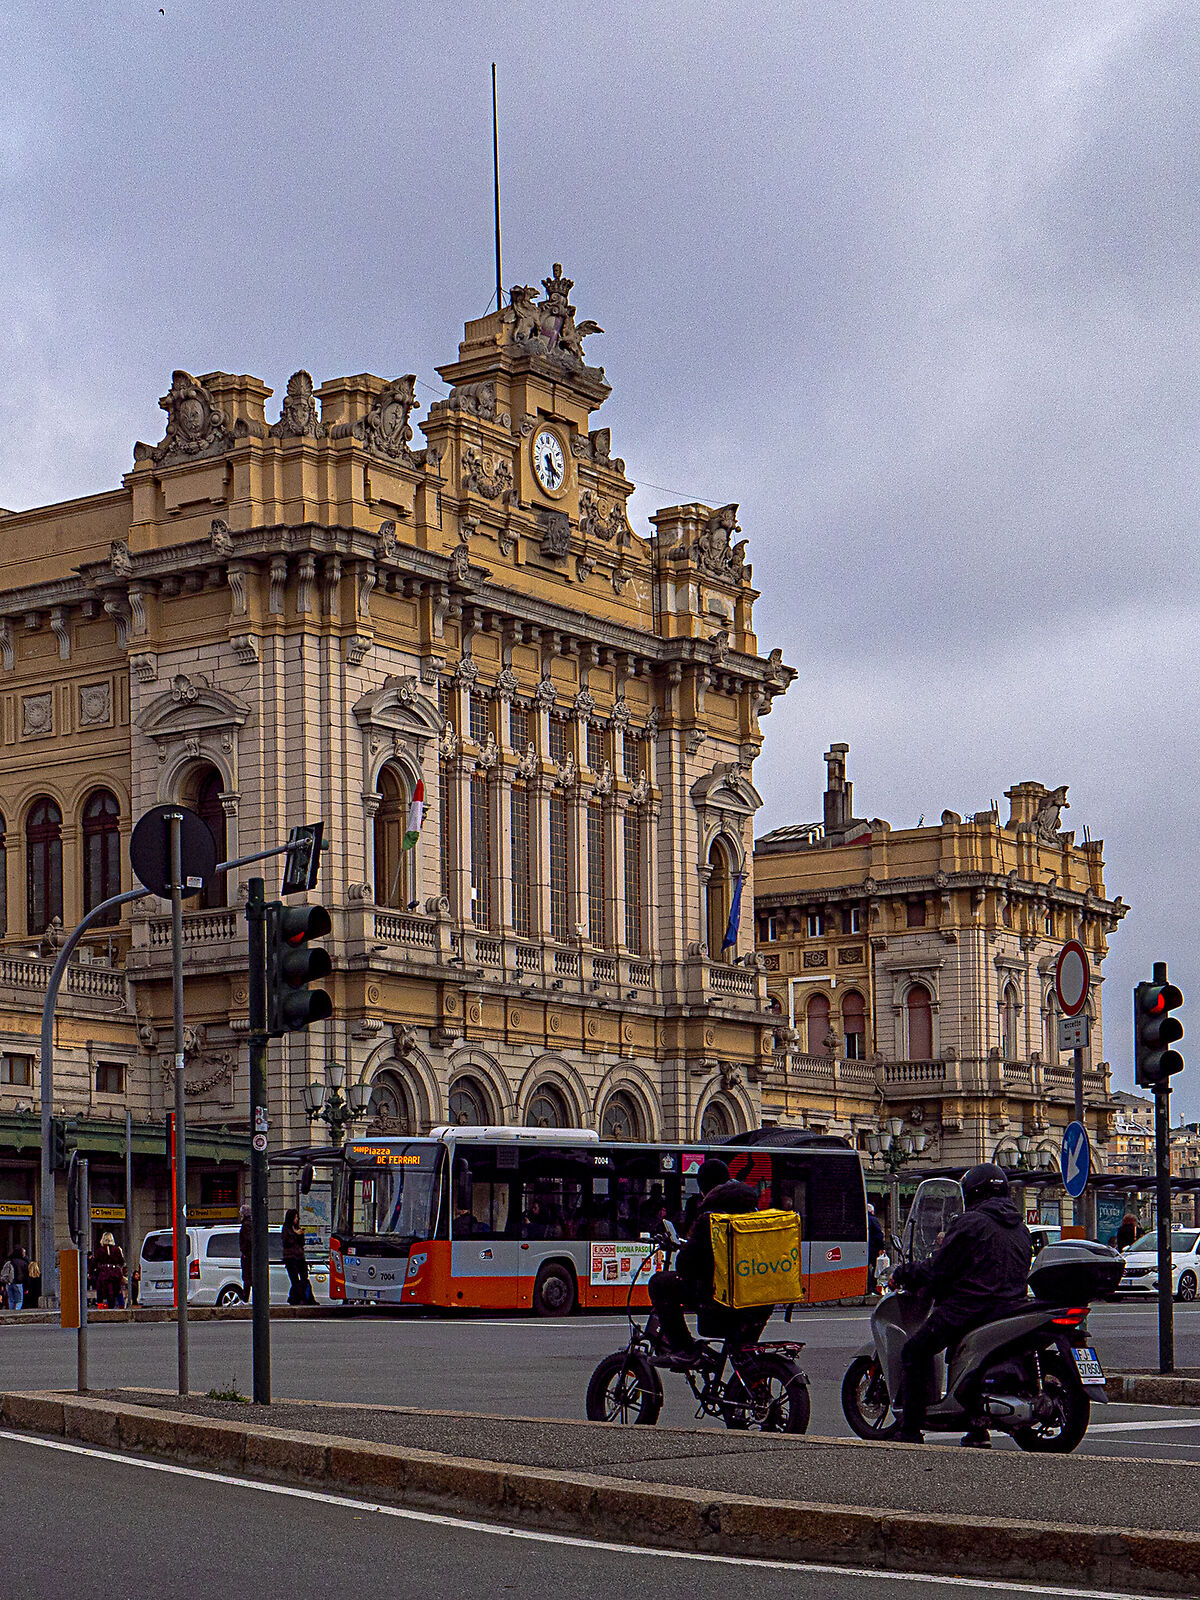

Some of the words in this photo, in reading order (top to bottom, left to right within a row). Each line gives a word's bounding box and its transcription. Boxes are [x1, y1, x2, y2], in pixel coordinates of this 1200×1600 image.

[364, 1146, 391, 1155] Piazza
[376, 1155, 387, 1164] DE
[388, 1155, 421, 1165] FERRARI
[594, 1156, 609, 1165] 7004
[736, 1259, 792, 1277] Glovo
[380, 1273, 395, 1281] 7004
